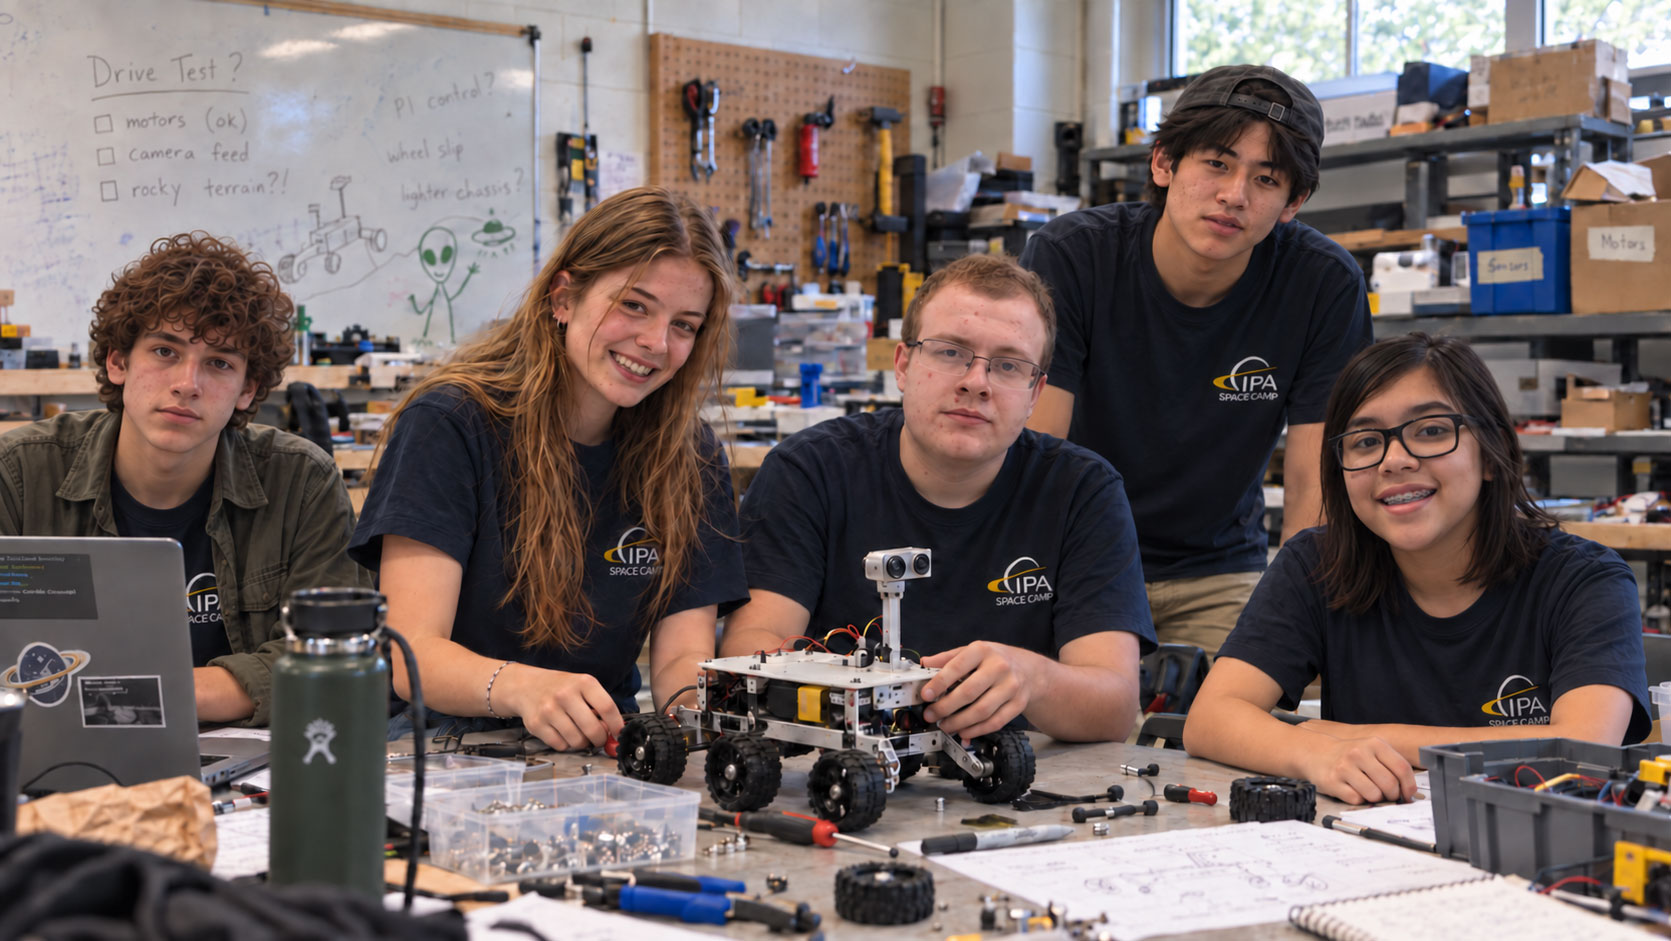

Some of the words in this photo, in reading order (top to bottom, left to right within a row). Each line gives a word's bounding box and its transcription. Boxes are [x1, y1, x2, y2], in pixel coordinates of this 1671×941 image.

[87, 55, 158, 88] Drive
[170, 53, 217, 83] Test
[126, 112, 186, 130] motors
[206, 106, 248, 135] (ok)
[129, 147, 195, 162] camera
[211, 141, 249, 162] feed
[387, 138, 430, 163] wheel
[132, 177, 181, 206] rocky
[204, 168, 289, 197] terrain?!
[1601, 234, 1646, 251] Motors
[1488, 257, 1529, 273] Sensors
[1242, 374, 1278, 392] IPA
[1219, 392, 1250, 401] SPACE
[1250, 391, 1279, 401] CAMP
[609, 566, 638, 576] SPACE
[1016, 575, 1053, 594] IPA
[197, 594, 221, 612] IP
[996, 595, 1026, 606] SPACE
[1027, 592, 1054, 603] CAMP
[188, 613, 208, 624] ACE
[209, 612, 224, 623] CA
[1509, 696, 1547, 717] IPA
[1520, 716, 1550, 726] CAMP
